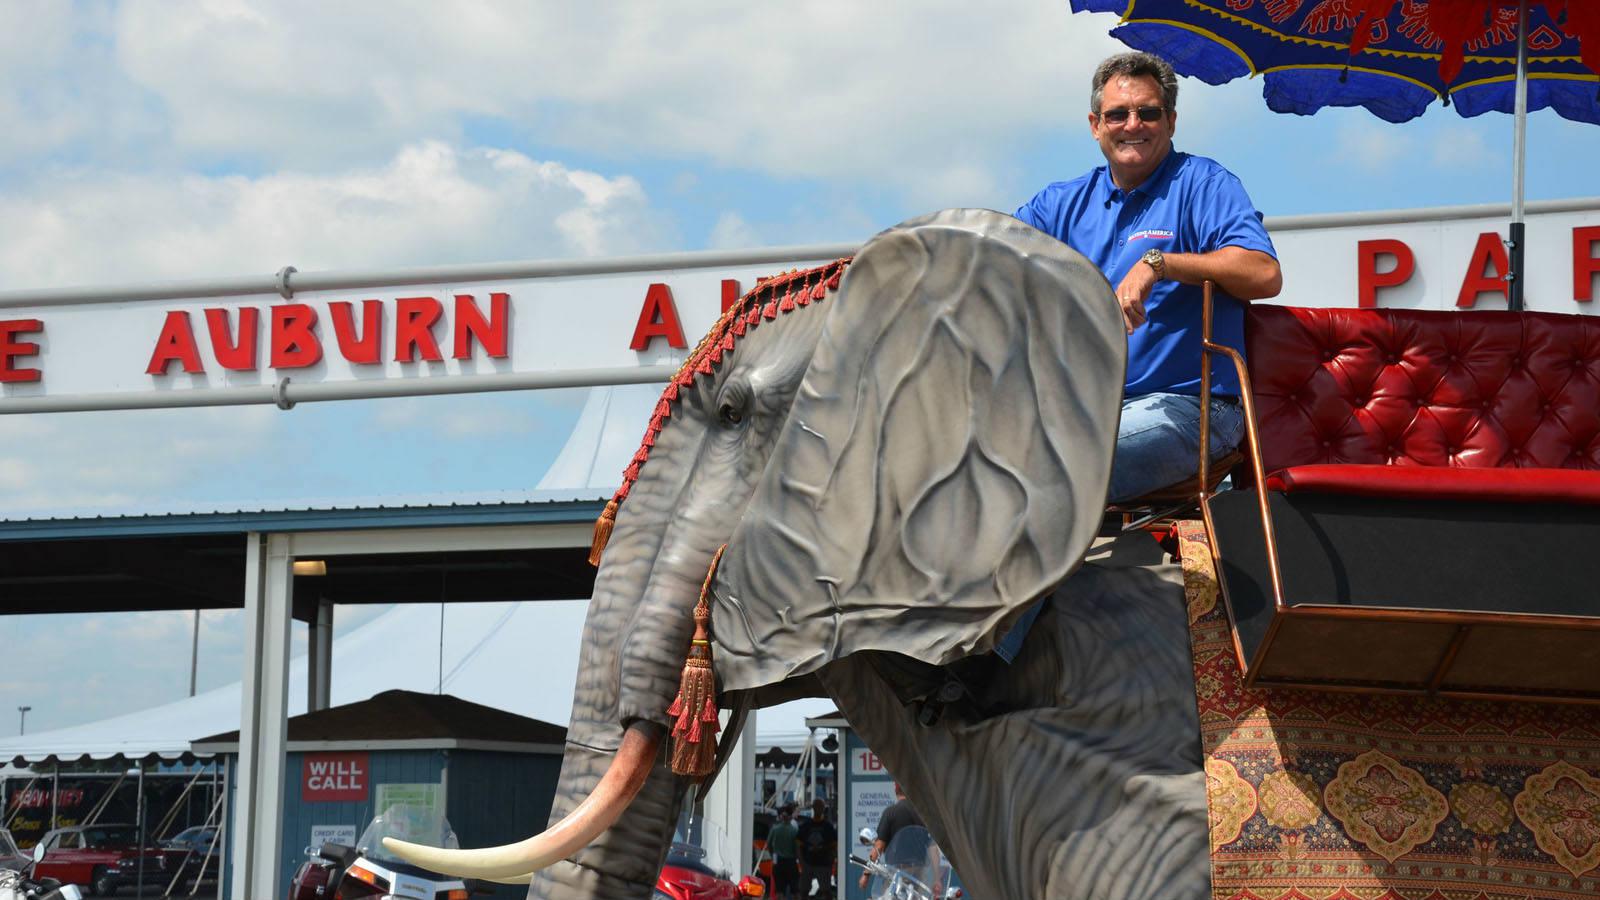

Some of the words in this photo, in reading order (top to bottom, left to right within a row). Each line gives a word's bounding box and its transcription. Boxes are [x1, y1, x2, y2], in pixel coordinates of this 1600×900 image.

[146, 292, 510, 375] AUBURN
[310, 761, 362, 775] WILL
[308, 776, 362, 790] CALL
[314, 829, 335, 837] CREDIT
